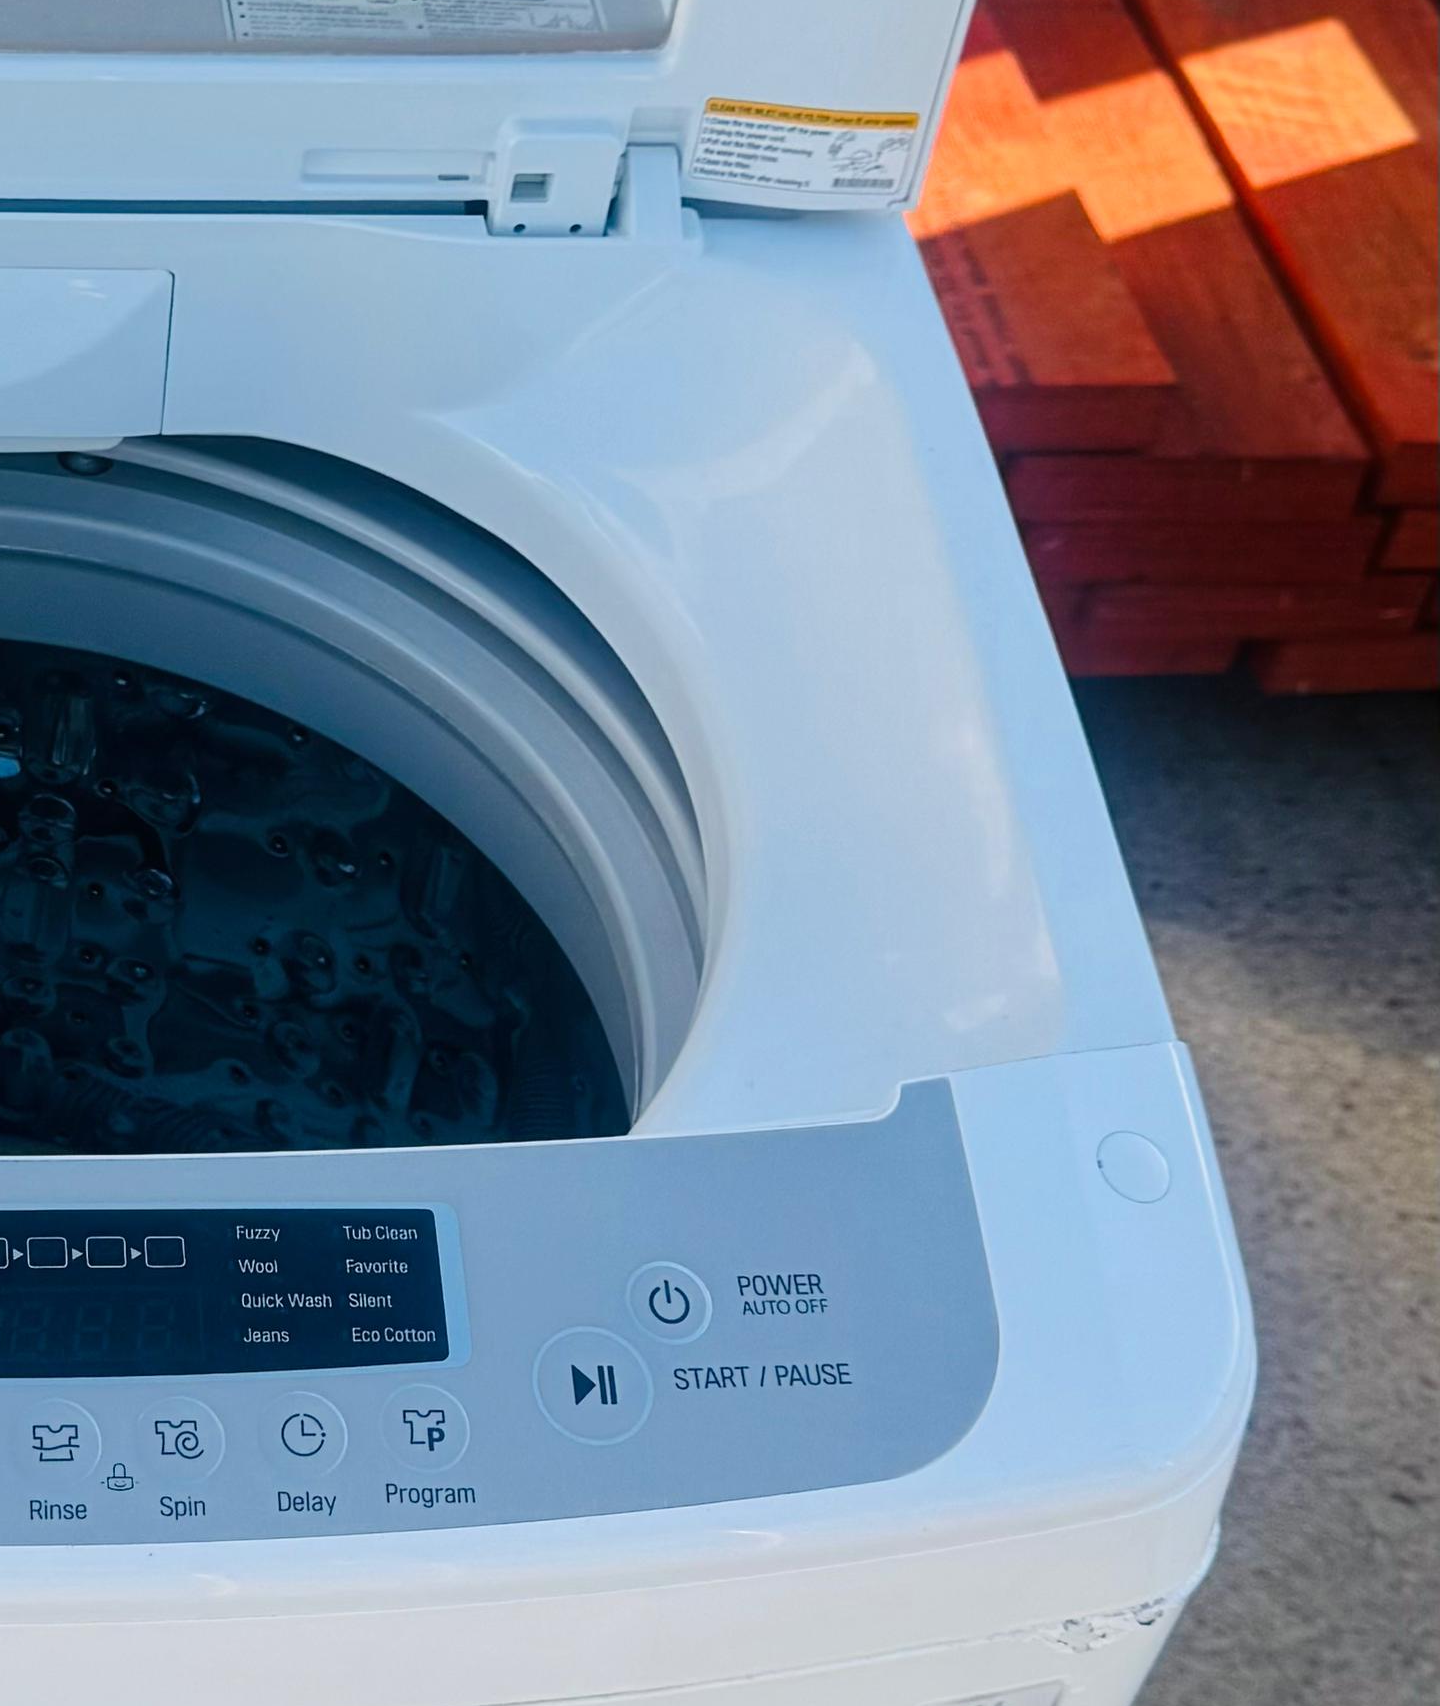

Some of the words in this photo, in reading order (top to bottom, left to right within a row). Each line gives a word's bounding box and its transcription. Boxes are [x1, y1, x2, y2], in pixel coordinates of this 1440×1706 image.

[236, 1225, 280, 1242] Fuzzy
[343, 1225, 371, 1240] Tub
[375, 1226, 418, 1240] Clean
[238, 1259, 278, 1274] Wool
[346, 1259, 408, 1274] Favorite
[737, 1274, 824, 1296] POWER
[241, 1292, 284, 1308] Quick
[288, 1293, 333, 1308] Wash
[348, 1293, 393, 1308] Silent
[742, 1300, 791, 1316] AUTO
[795, 1298, 828, 1314] OFF
[243, 1328, 290, 1343] Jeans
[352, 1327, 380, 1342] Eco
[384, 1327, 436, 1343] Cotton
[673, 1365, 749, 1391] START
[775, 1363, 853, 1386] PAUSE
[277, 1491, 337, 1516] Delay
[385, 1483, 476, 1509] Program
[29, 1499, 87, 1521] Rinse
[159, 1496, 206, 1521] Spin
